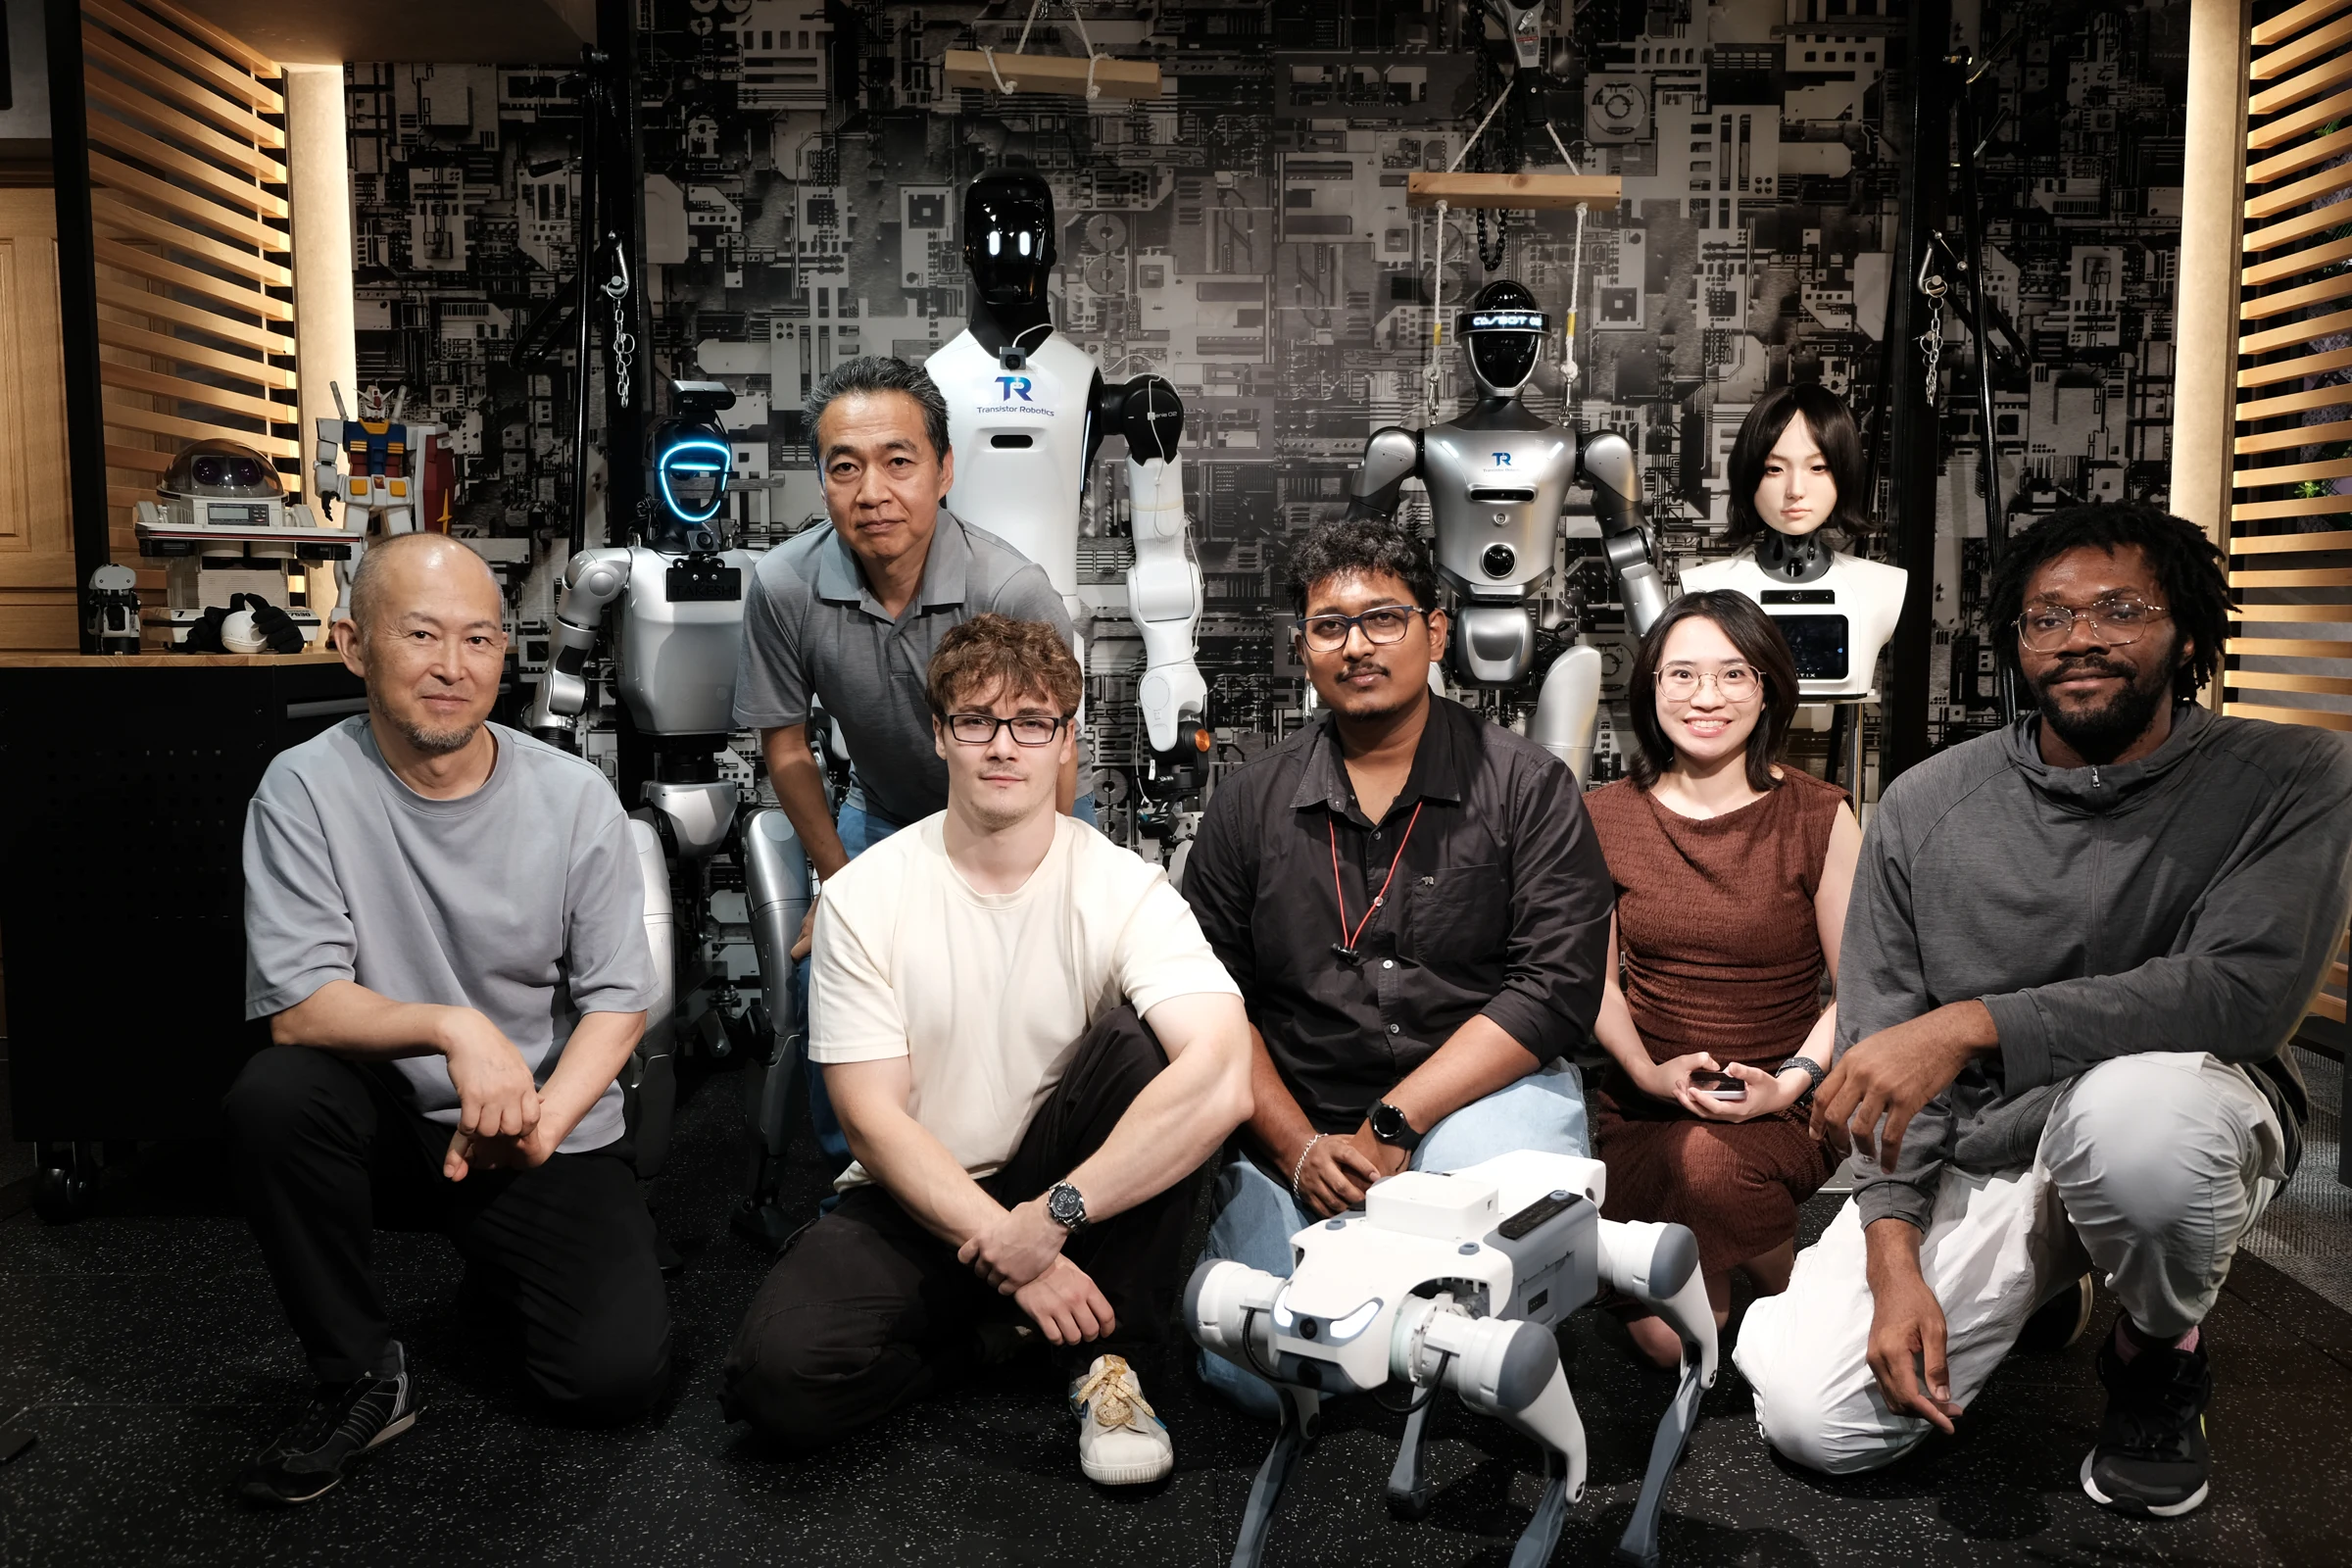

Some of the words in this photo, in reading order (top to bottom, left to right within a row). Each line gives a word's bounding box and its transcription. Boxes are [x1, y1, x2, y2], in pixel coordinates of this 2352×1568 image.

[994, 376, 1033, 402] TR
[1019, 406, 1054, 416] Robotics
[1492, 452, 1512, 466] TR
[672, 585, 736, 597] TAKESHI
